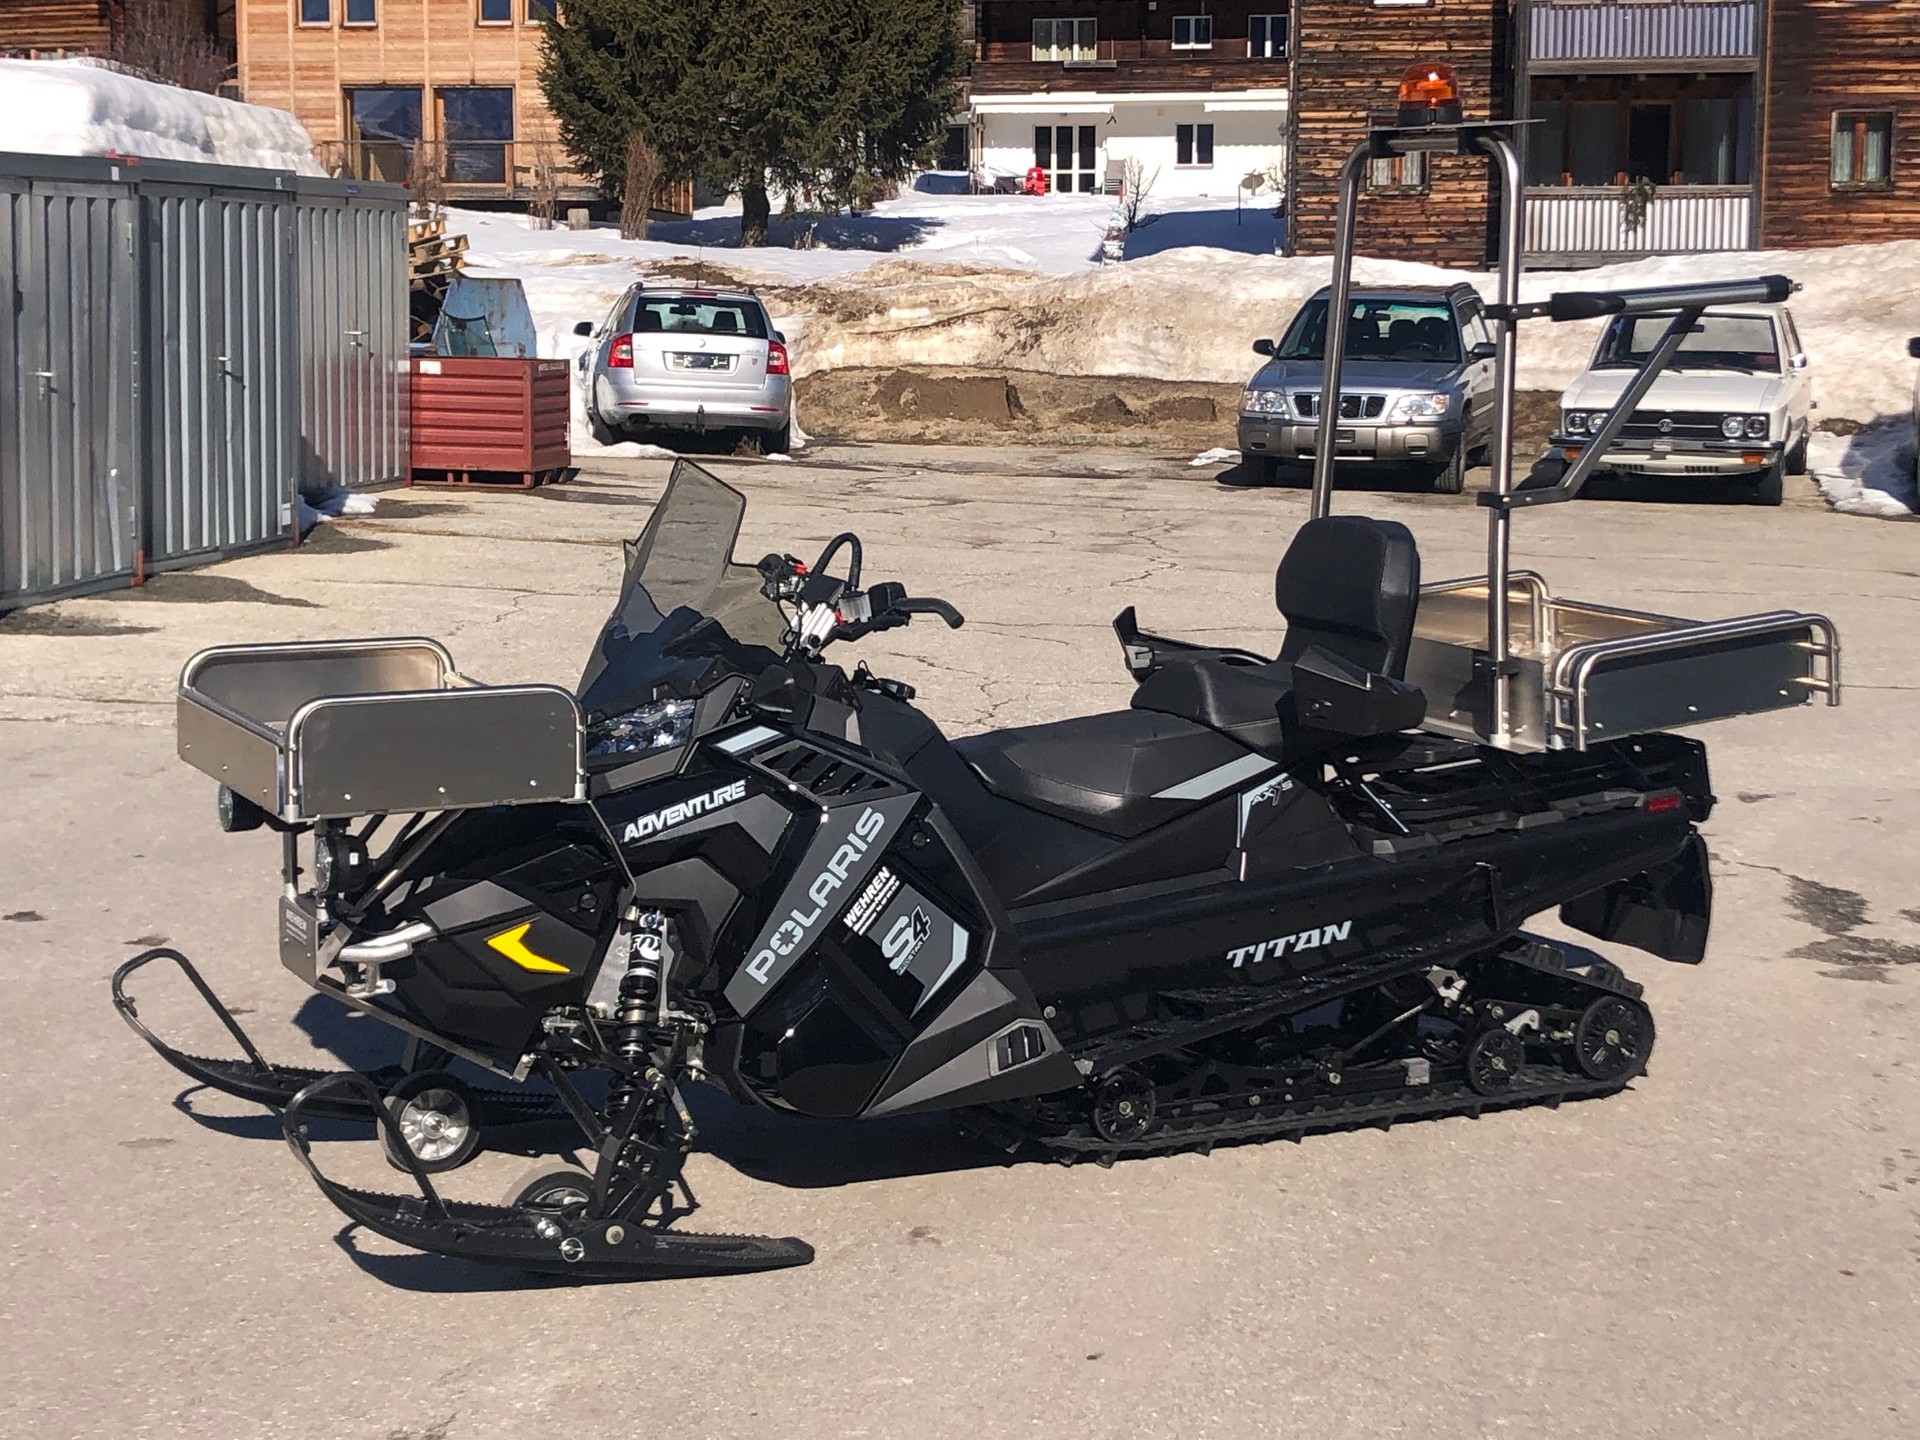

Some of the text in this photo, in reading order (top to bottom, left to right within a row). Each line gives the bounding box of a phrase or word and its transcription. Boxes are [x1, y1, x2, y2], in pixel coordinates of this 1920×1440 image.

[624, 780, 746, 842] ADVENTURE
[745, 806, 885, 985] POLARIS
[843, 866, 890, 928] WEHREN
[881, 905, 931, 970] S4
[1226, 920, 1352, 968] TITAN
